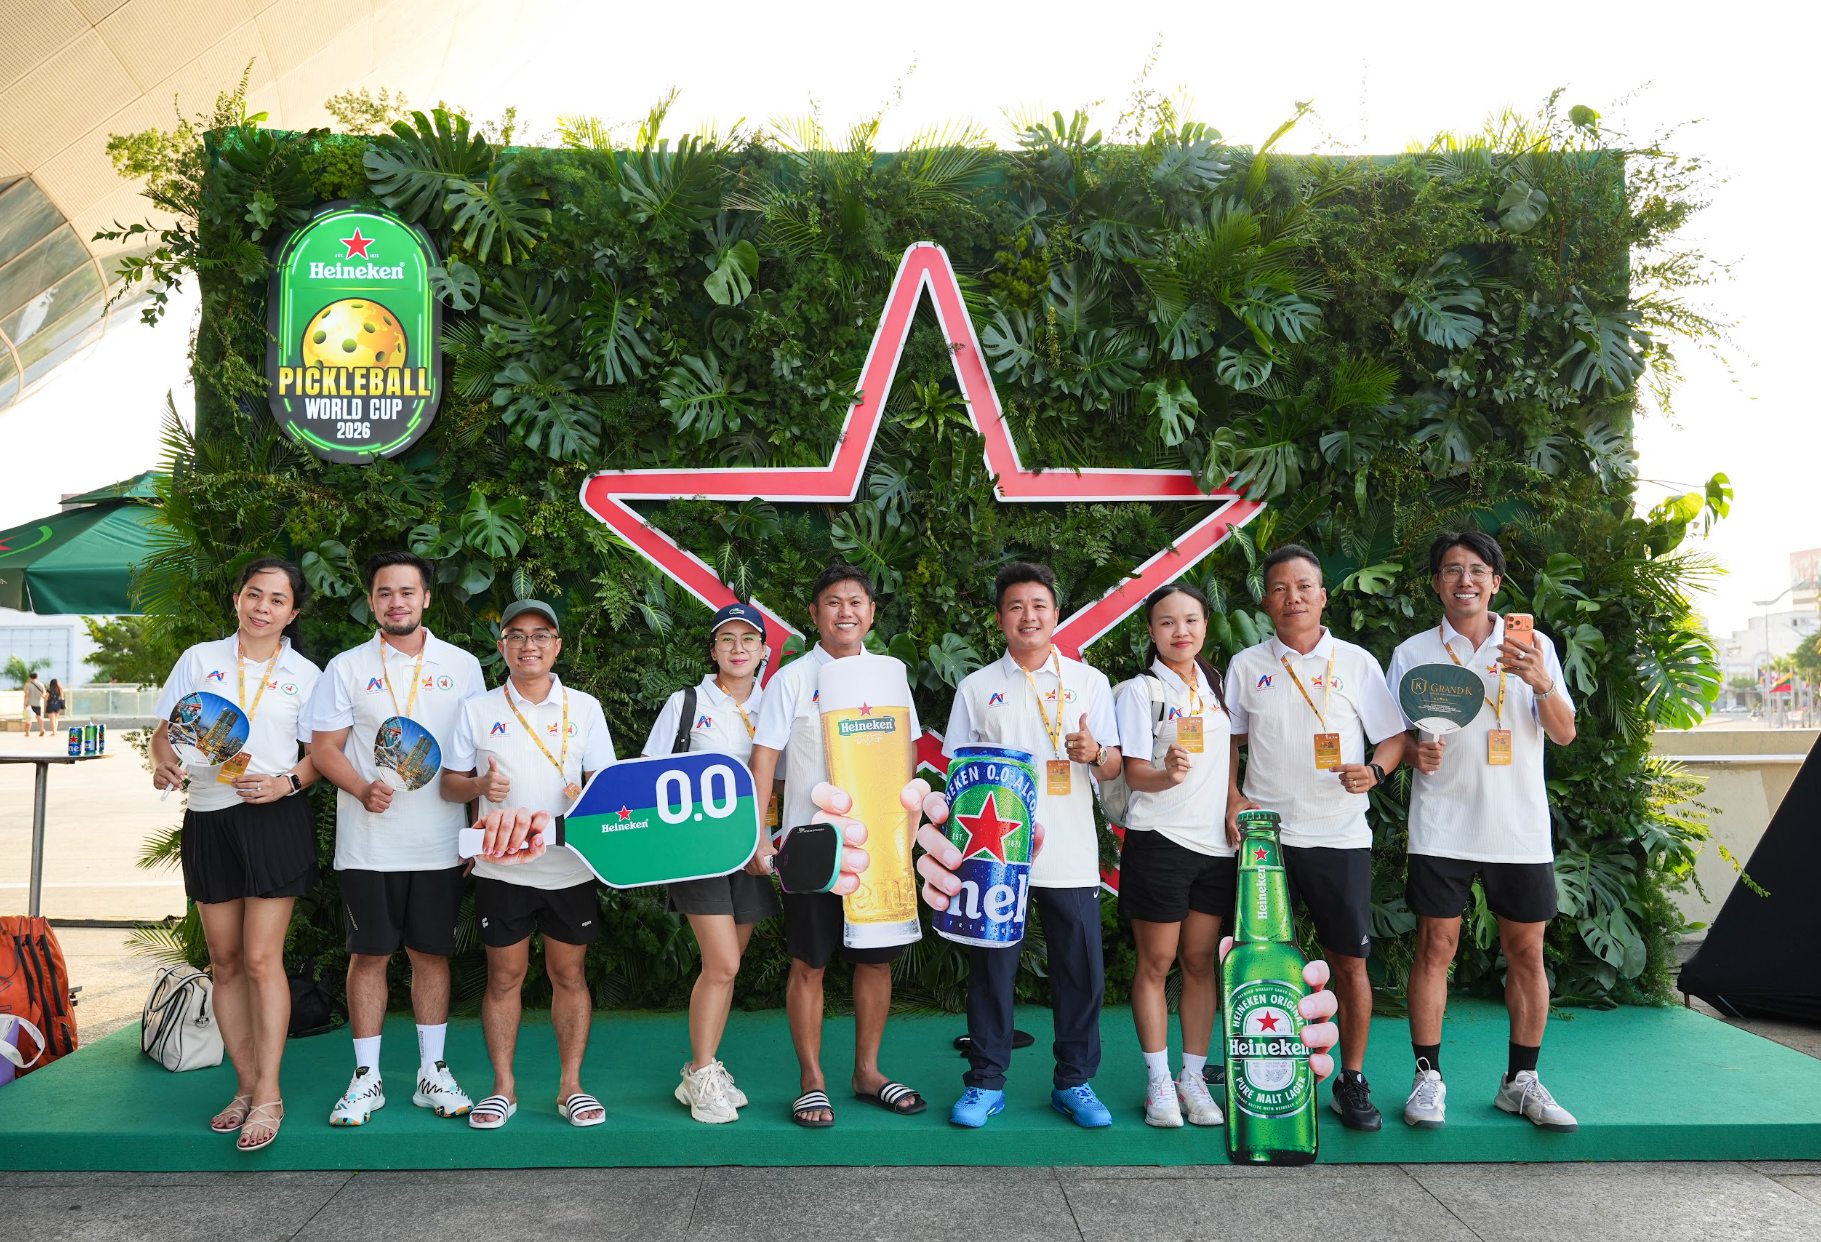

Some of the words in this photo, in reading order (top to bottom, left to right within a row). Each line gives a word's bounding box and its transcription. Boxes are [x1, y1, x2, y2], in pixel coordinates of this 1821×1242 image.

[309, 262, 404, 279] Heineken
[278, 367, 431, 396] PICKLEBALL
[304, 398, 362, 420] WORLD
[369, 398, 403, 420] CUP
[336, 421, 371, 439] 2026
[840, 720, 893, 733] Heineken
[986, 764, 1010, 783] 0.0
[655, 764, 738, 825] 0.0
[601, 820, 649, 833] Heineken
[1257, 864, 1268, 920] Heineken
[1232, 993, 1267, 1028] HEINEKEN
[1270, 994, 1304, 1028] ORIGINAL
[1236, 1076, 1255, 1099] PURE
[1255, 1093, 1282, 1104] MALT
[1284, 1076, 1306, 1101] LAGER
